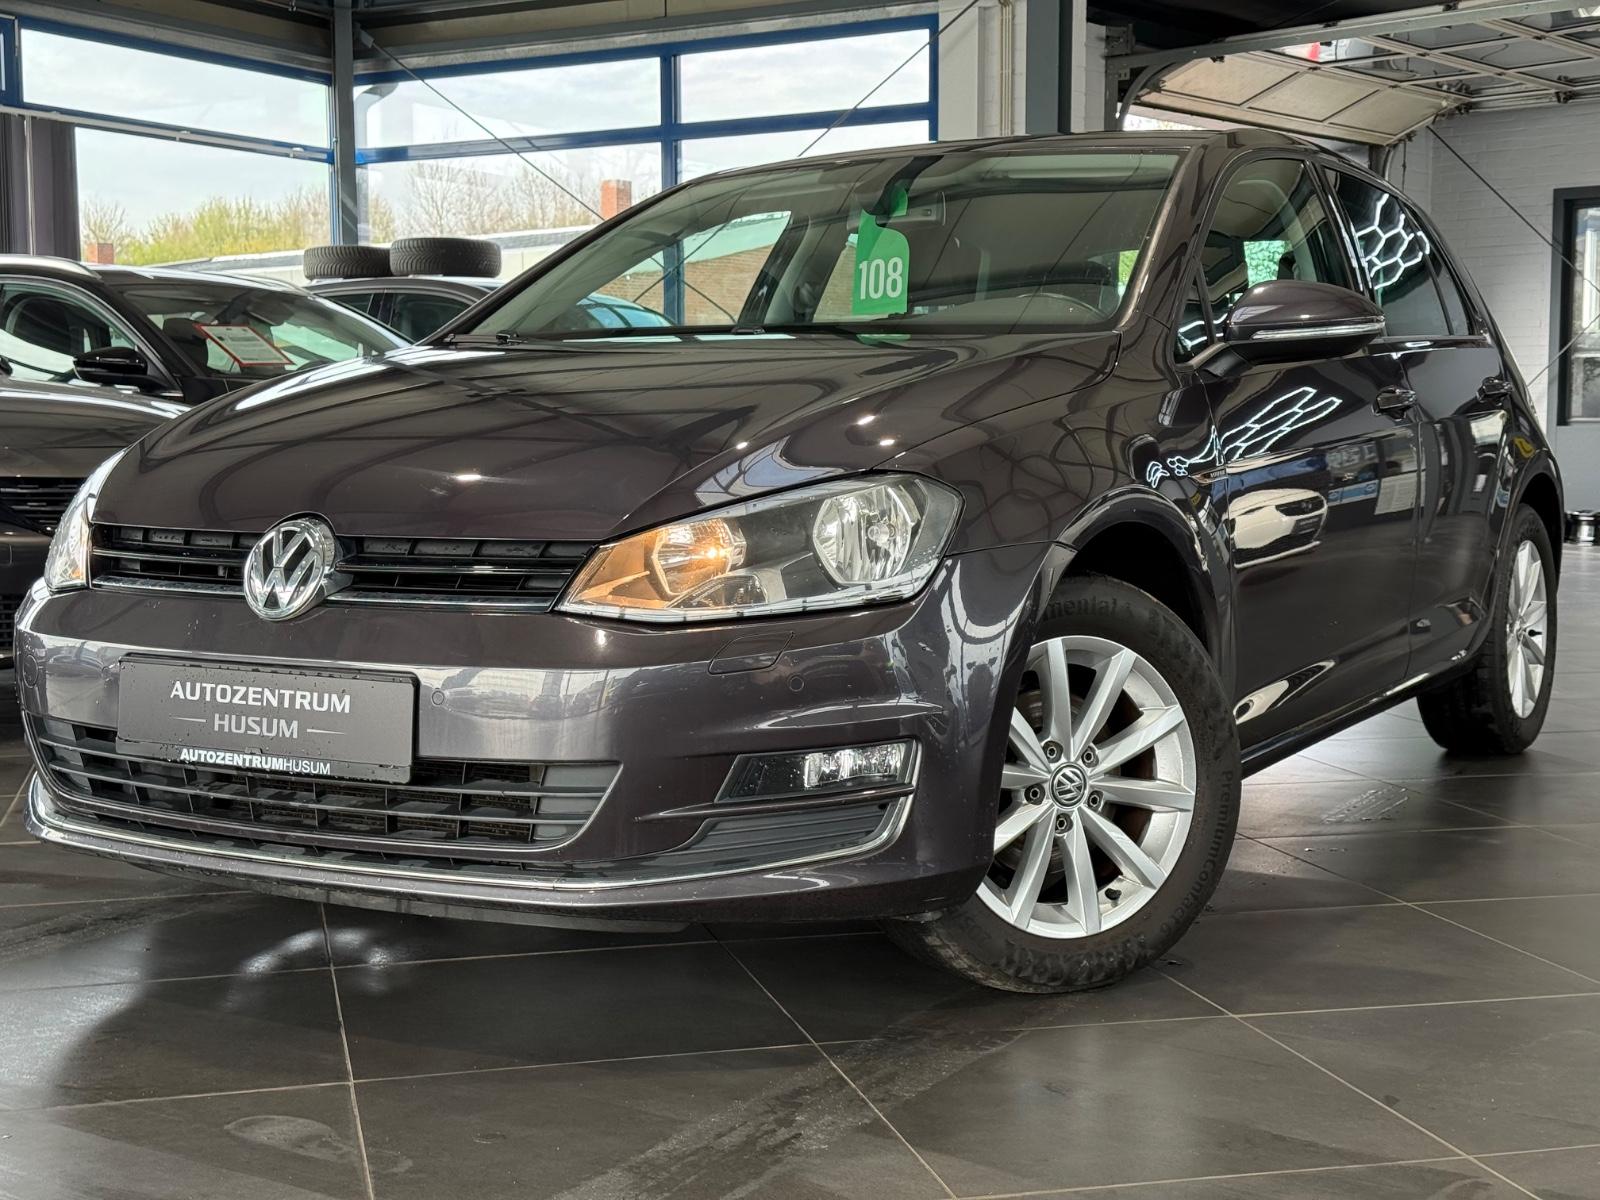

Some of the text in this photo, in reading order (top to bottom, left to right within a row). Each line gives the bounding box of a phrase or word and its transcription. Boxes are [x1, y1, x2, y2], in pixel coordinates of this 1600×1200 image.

[858, 257, 903, 300] 108
[244, 520, 325, 621] VW
[169, 680, 351, 714] AUTOZENTRUM
[213, 713, 299, 739] HUSUM
[180, 748, 331, 776] AUTOZENTRUMHUSUM
